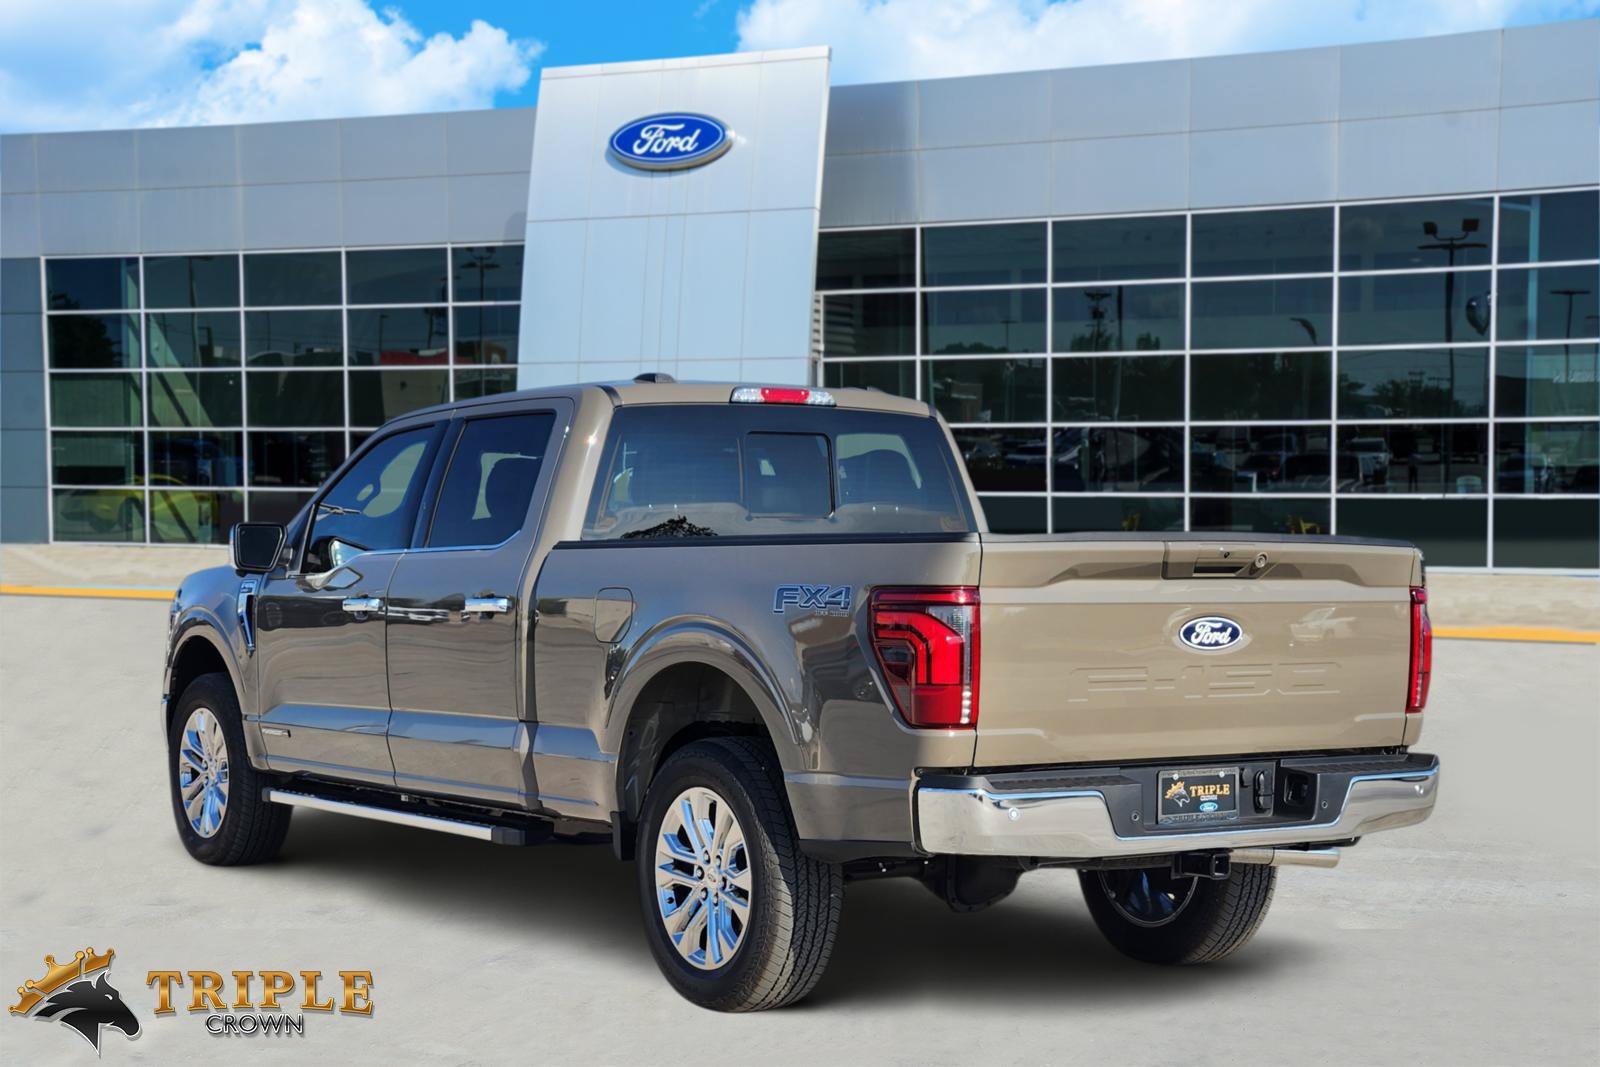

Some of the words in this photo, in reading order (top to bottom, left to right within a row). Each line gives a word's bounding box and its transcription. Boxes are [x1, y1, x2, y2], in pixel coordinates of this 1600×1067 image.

[632, 123, 702, 155] Ford
[773, 584, 851, 613] FX4
[1191, 621, 1232, 644] Ford
[1189, 783, 1231, 798] TRIPLE
